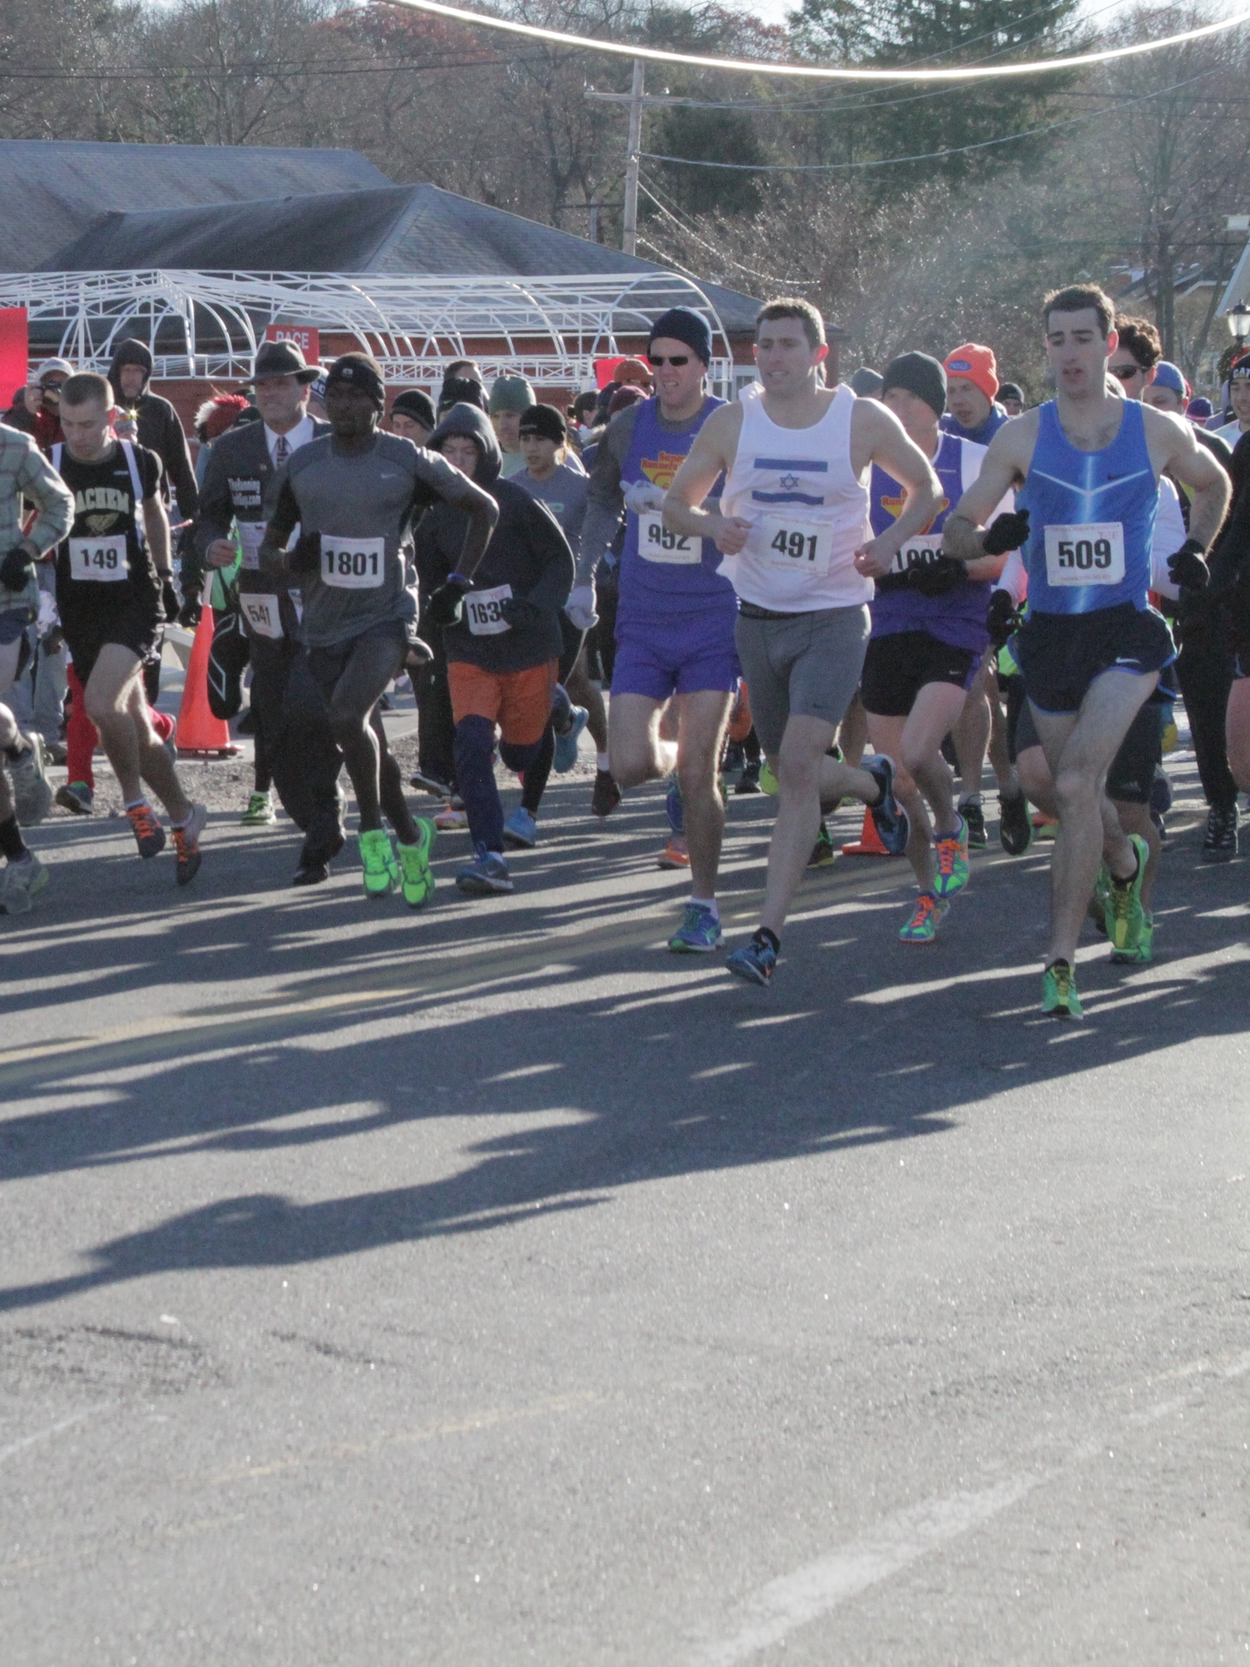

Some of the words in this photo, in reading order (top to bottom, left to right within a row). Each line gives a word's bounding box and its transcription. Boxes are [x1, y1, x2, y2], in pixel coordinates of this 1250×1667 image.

[75, 487, 129, 514] ACHEM
[648, 523, 691, 551] 952
[771, 529, 818, 561] 491
[81, 548, 118, 569] 149
[325, 550, 378, 576] 1801
[1058, 539, 1112, 570] 509
[247, 605, 271, 626] 541
[470, 599, 505, 624] 163
